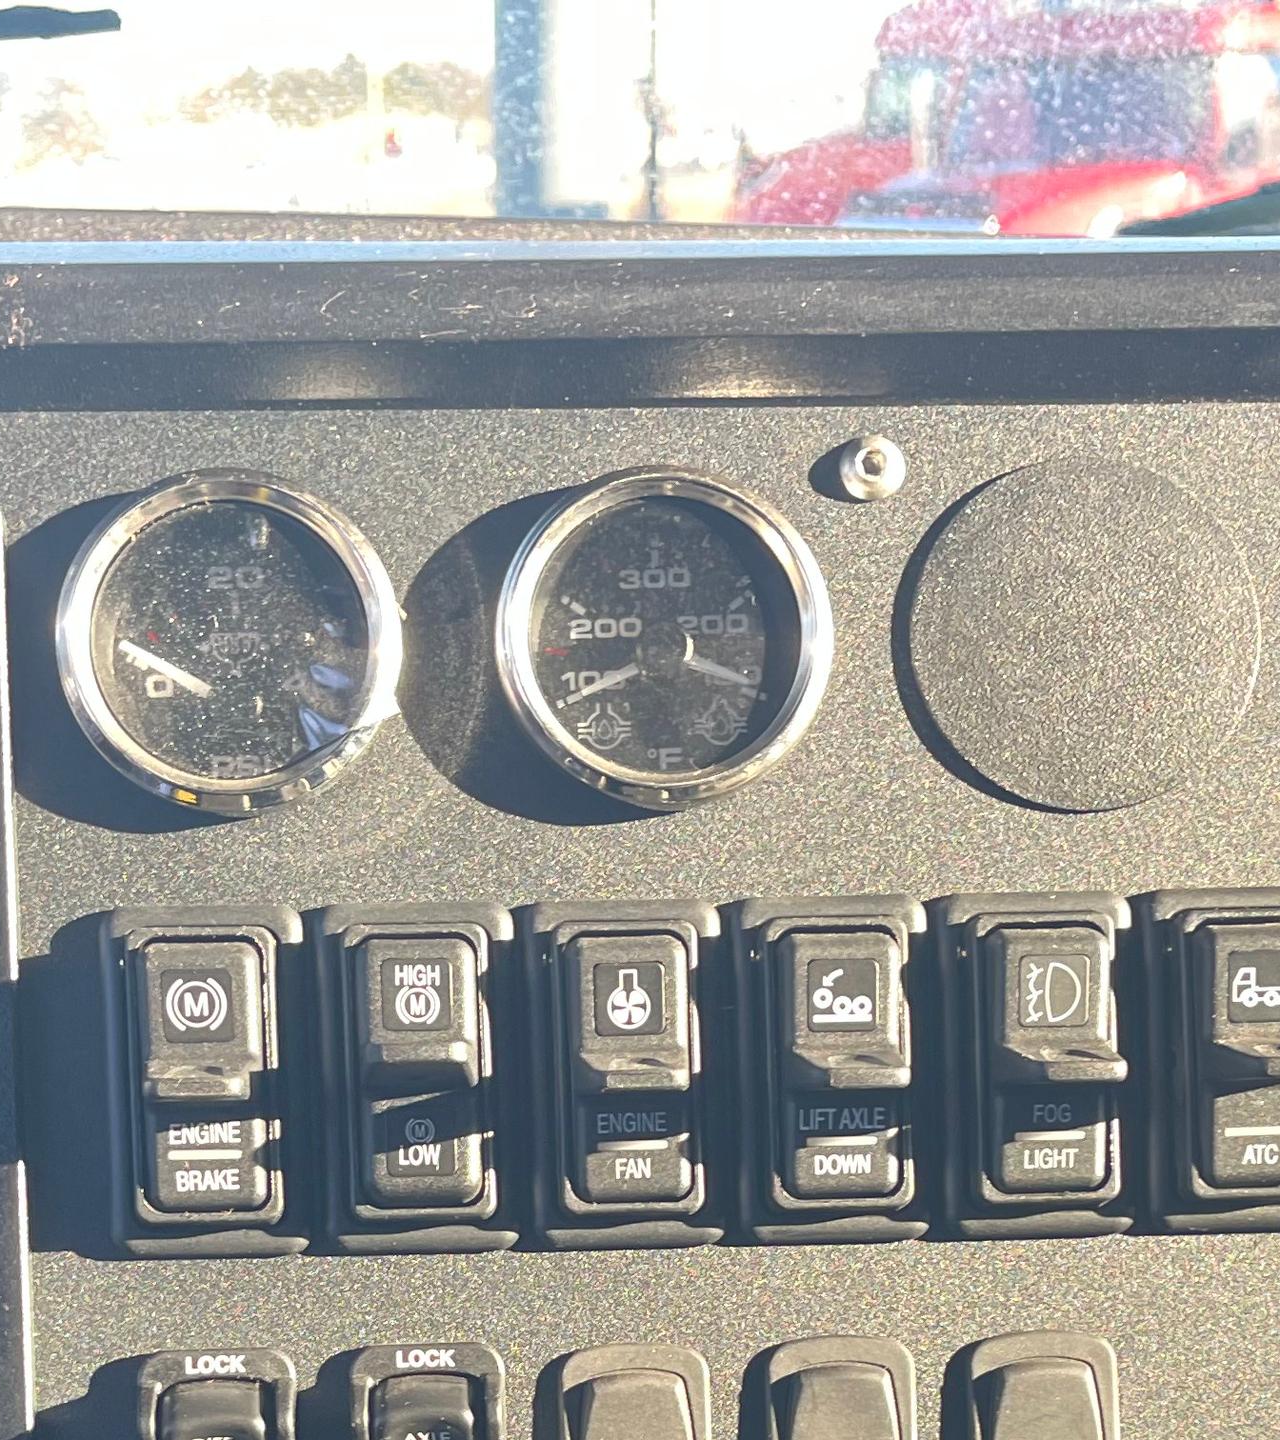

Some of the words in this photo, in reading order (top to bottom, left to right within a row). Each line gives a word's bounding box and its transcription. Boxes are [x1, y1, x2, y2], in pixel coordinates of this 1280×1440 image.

[619, 569, 691, 589] 300
[570, 618, 642, 639] 200
[678, 614, 748, 633] 200
[145, 674, 174, 698] 0
[395, 965, 440, 987] HIGH
[597, 1112, 666, 1134] ENGINE
[799, 1109, 837, 1131] LIFT
[839, 1107, 885, 1129] AXLE
[1033, 1104, 1071, 1123] FOG
[169, 1120, 241, 1145] ENGINE
[398, 1144, 440, 1166] LOW
[814, 1154, 871, 1175] DOWN
[1024, 1148, 1078, 1170] LIGHT
[1241, 1144, 1279, 1165] ATC
[615, 1158, 651, 1179] FAN
[176, 1169, 240, 1192] BRAKE
[185, 1354, 246, 1375] LOCK
[395, 1349, 455, 1368] LOCK
